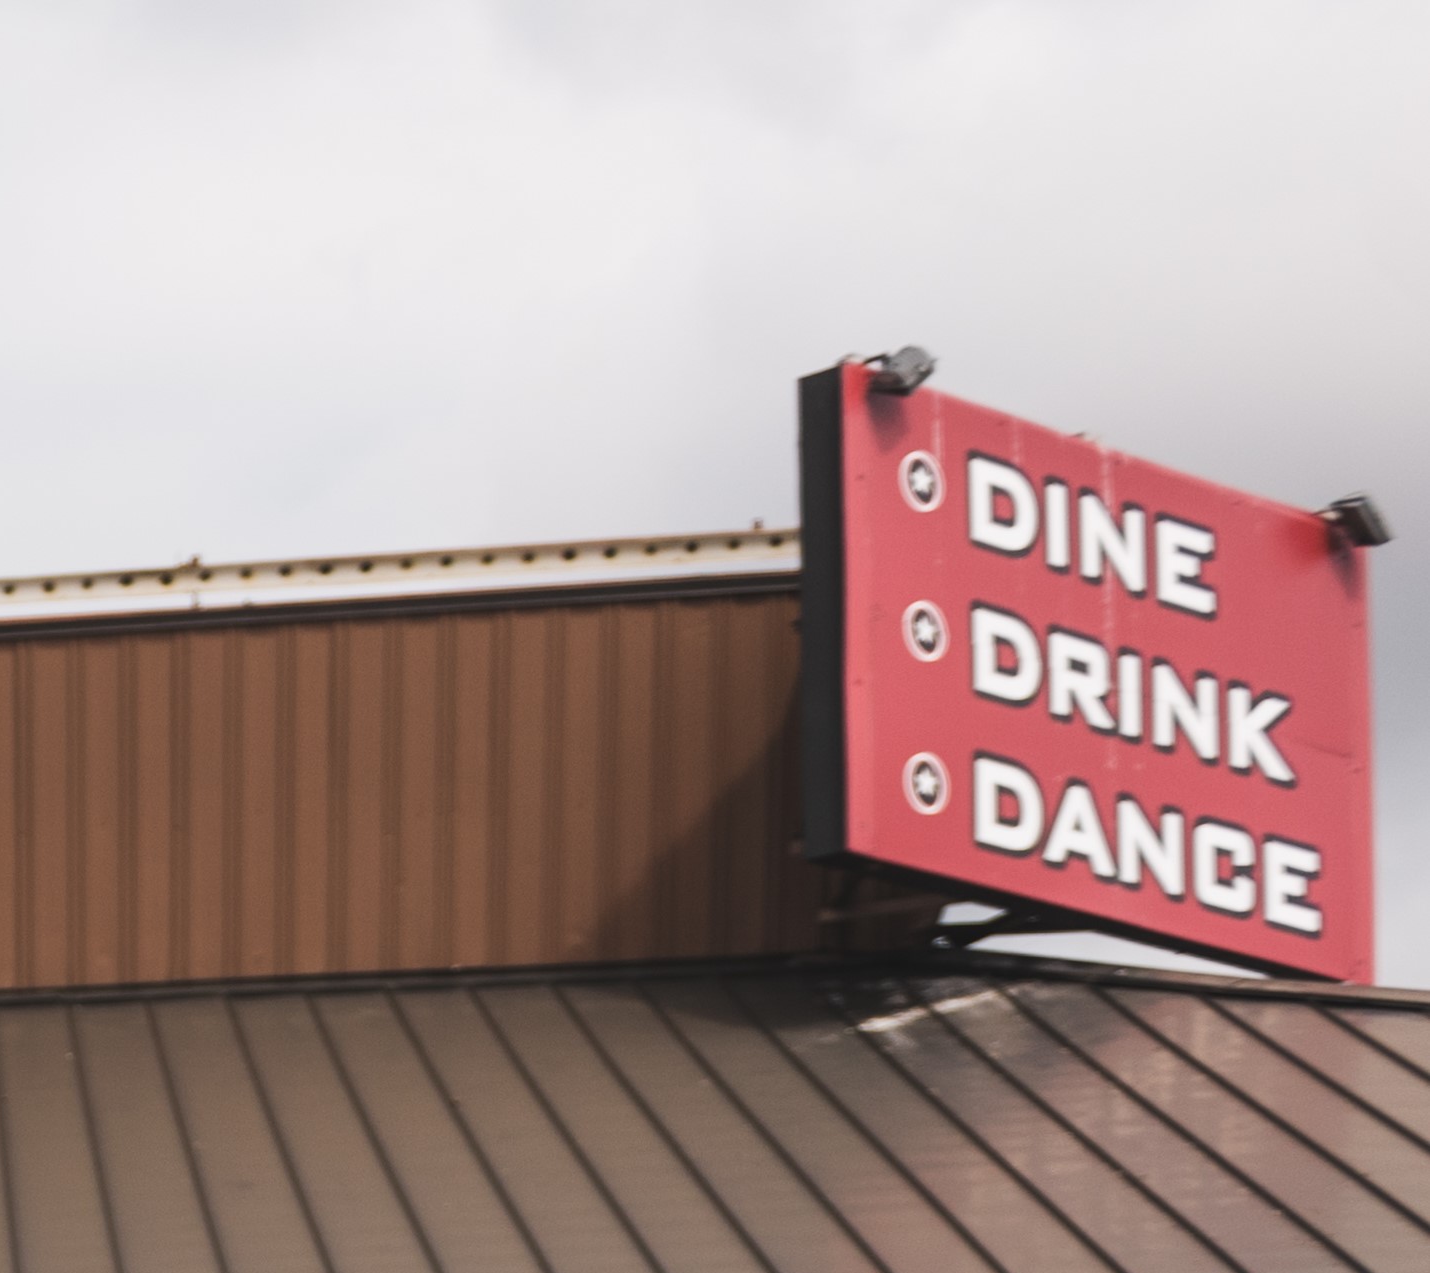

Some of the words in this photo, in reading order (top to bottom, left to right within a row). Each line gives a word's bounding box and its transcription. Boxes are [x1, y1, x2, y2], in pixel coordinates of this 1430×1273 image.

[966, 451, 1218, 619] DINE
[968, 600, 1297, 788] DRINK
[971, 751, 1324, 935] DANCE
